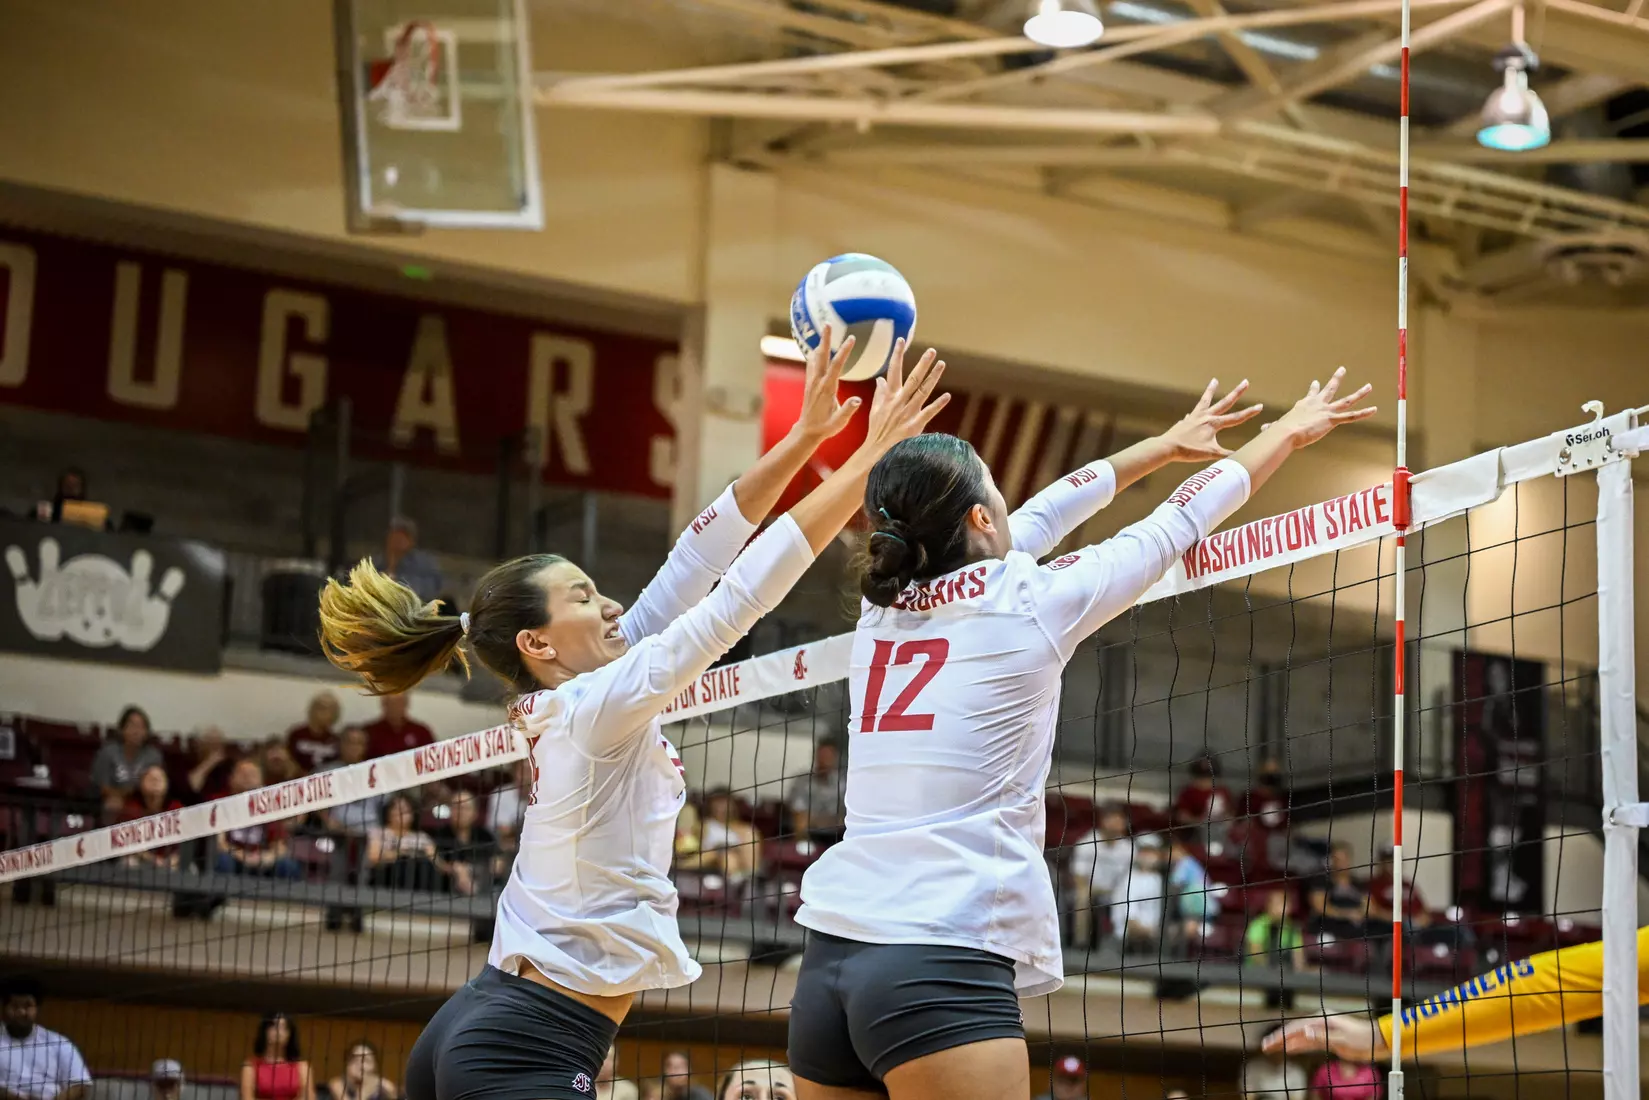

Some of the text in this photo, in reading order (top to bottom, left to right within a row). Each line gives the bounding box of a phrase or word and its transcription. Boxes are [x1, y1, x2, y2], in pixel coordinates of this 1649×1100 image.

[1064, 467, 1098, 488] WSU
[1166, 466, 1223, 508] COUGARS
[690, 505, 718, 535] WSU
[1181, 484, 1389, 581] WASHINGTON STATE
[701, 665, 740, 703] STATE
[860, 637, 950, 733] 12
[413, 724, 515, 776] WASHINGTON STATE
